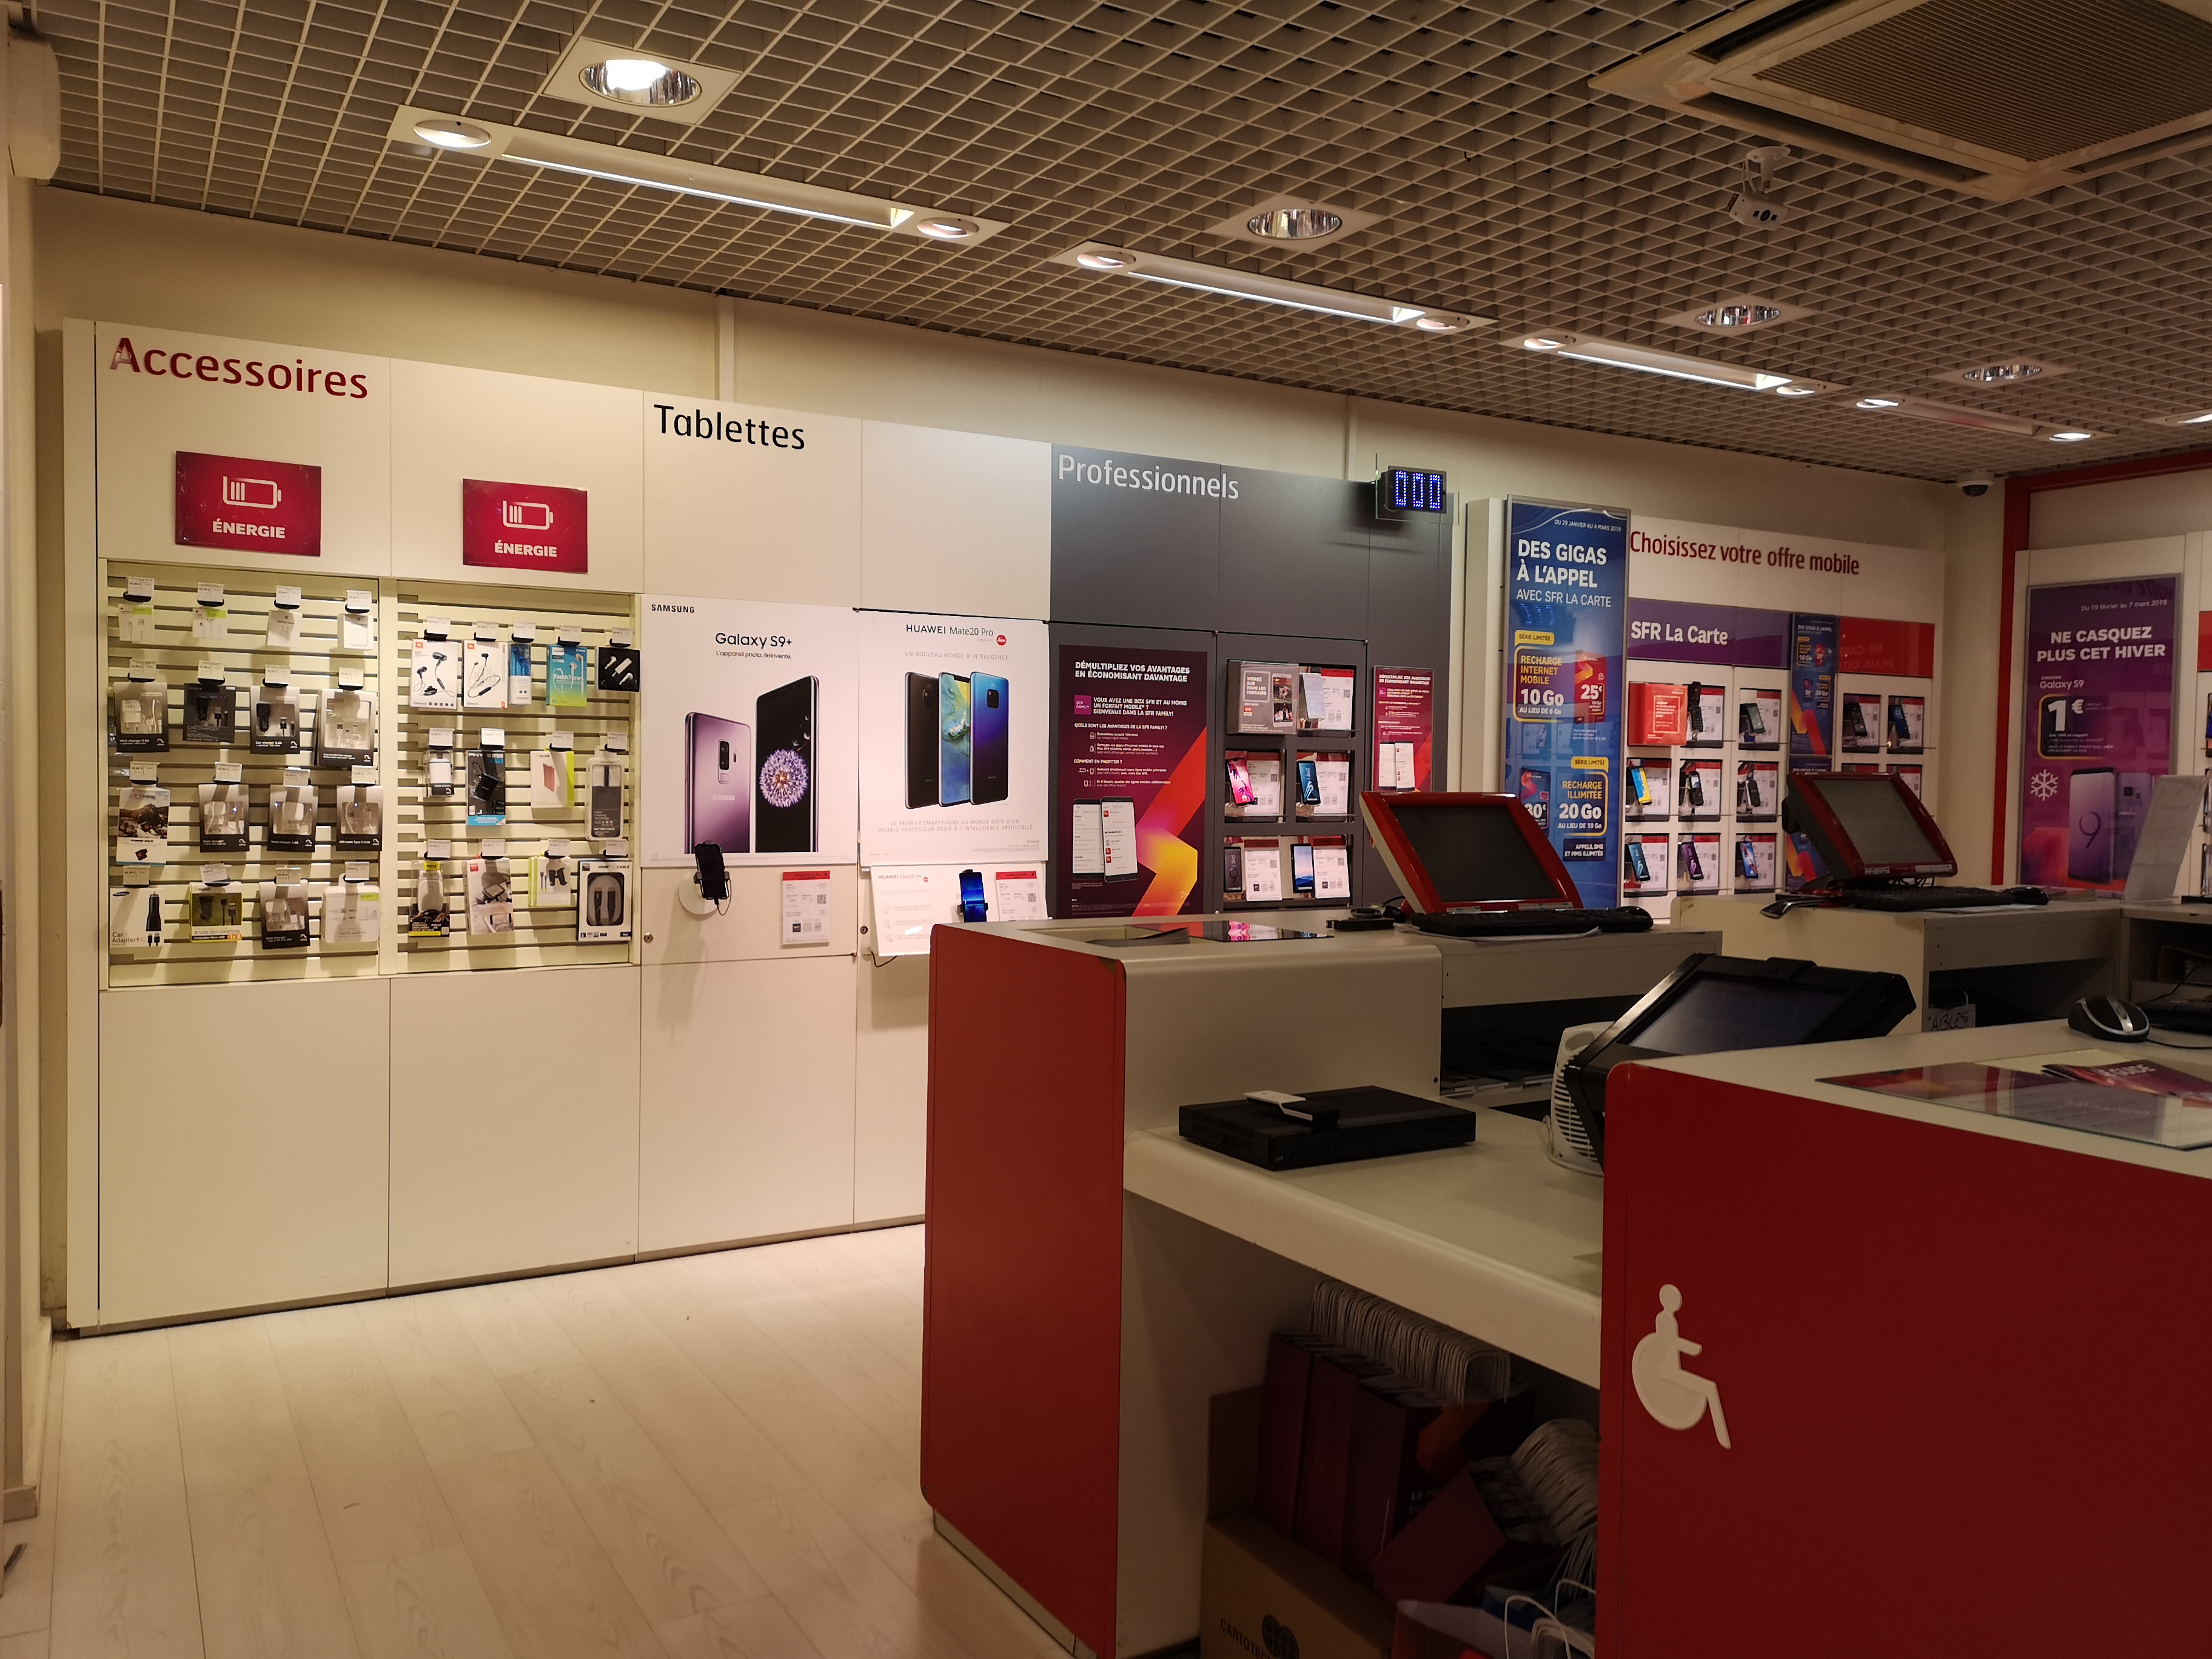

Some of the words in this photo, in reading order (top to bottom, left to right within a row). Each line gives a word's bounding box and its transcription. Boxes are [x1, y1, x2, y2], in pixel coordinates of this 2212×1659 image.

[111, 338, 369, 399] Accessoires
[654, 404, 805, 449] Tablettes
[1058, 454, 1239, 499] Professionnels
[1395, 471, 1443, 510] 000
[213, 519, 286, 539] ÉNERGIE
[494, 542, 557, 558] ÉNERGIE
[1518, 539, 1550, 559] DES
[1556, 544, 1607, 565] GIGAS
[1631, 531, 1716, 560] Choisissez
[1721, 545, 1761, 565] votre
[1768, 548, 1805, 569] offre
[1809, 554, 1859, 575] mobile
[1517, 558, 1529, 581] À
[1535, 566, 1598, 588] L'APPEL
[1517, 589, 1542, 601] AVEC
[1545, 591, 1563, 603] SFR
[1566, 594, 1578, 604] LA
[1581, 594, 1612, 607] CARTE
[651, 604, 694, 613] SAMSUNG
[907, 625, 946, 634] HUAWEI
[1631, 621, 1661, 640] SFR
[1666, 623, 1683, 642] La
[1687, 625, 1728, 645] Carte
[2051, 631, 2072, 644] NE
[2076, 626, 2152, 643] CASQUEZ
[716, 633, 767, 649] Galaxy
[771, 636, 792, 647] S9+
[1521, 655, 1562, 666] RECHARGE
[2037, 649, 2076, 662] PLUS
[2080, 646, 2110, 660] CET
[2115, 645, 2166, 659] HIVER
[1075, 660, 1128, 671] DÉMULTIPLIEZ
[1147, 665, 1190, 674] AVANTAGES
[1088, 669, 1142, 680] ÉCONOMISANT
[1144, 674, 1188, 682] DAVANTAGE
[1521, 665, 1558, 675] INTERNET
[1521, 675, 1549, 685] MOBILE
[2040, 681, 2072, 690] Galaxy
[1521, 689, 1540, 705] 10
[1543, 690, 1564, 706] Go
[2048, 700, 2066, 732] 1
[2071, 699, 2084, 714] €
[1563, 781, 1602, 789] RECHARGE
[1567, 789, 1602, 799] ILLIMITÉE
[1559, 803, 1579, 819] 20
[1581, 803, 1601, 819] Go
